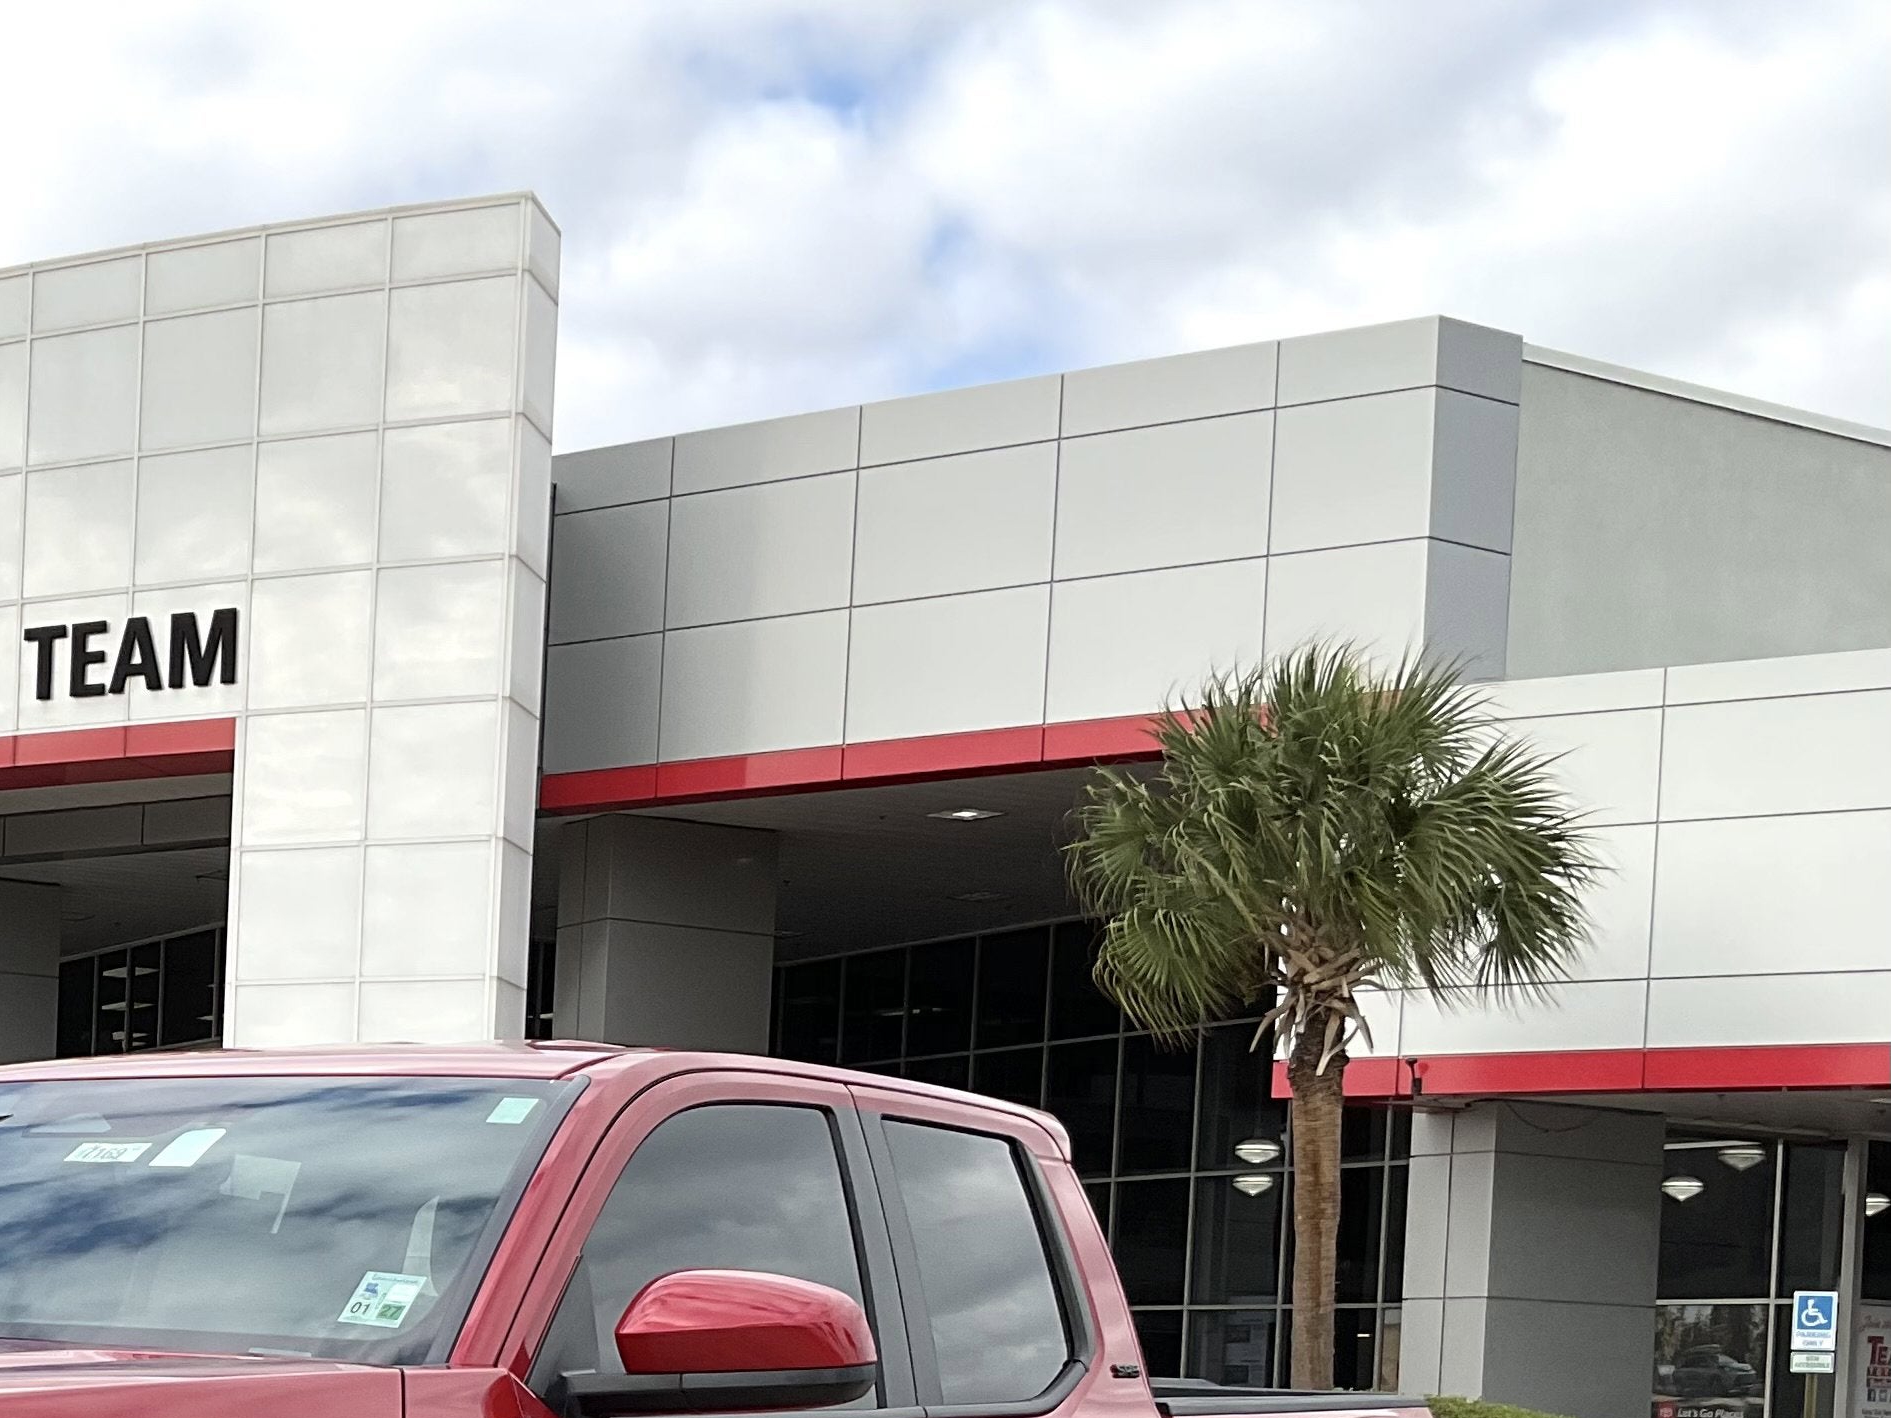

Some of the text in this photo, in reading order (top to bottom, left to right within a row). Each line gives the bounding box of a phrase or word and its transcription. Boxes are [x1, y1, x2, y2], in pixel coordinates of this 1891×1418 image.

[24, 607, 238, 700] TEAM
[350, 1302, 403, 1319] 01 27
[1867, 1335, 1891, 1366] TE
[1677, 1408, 1698, 1418] Let's
[1699, 1408, 1714, 1418] Go
